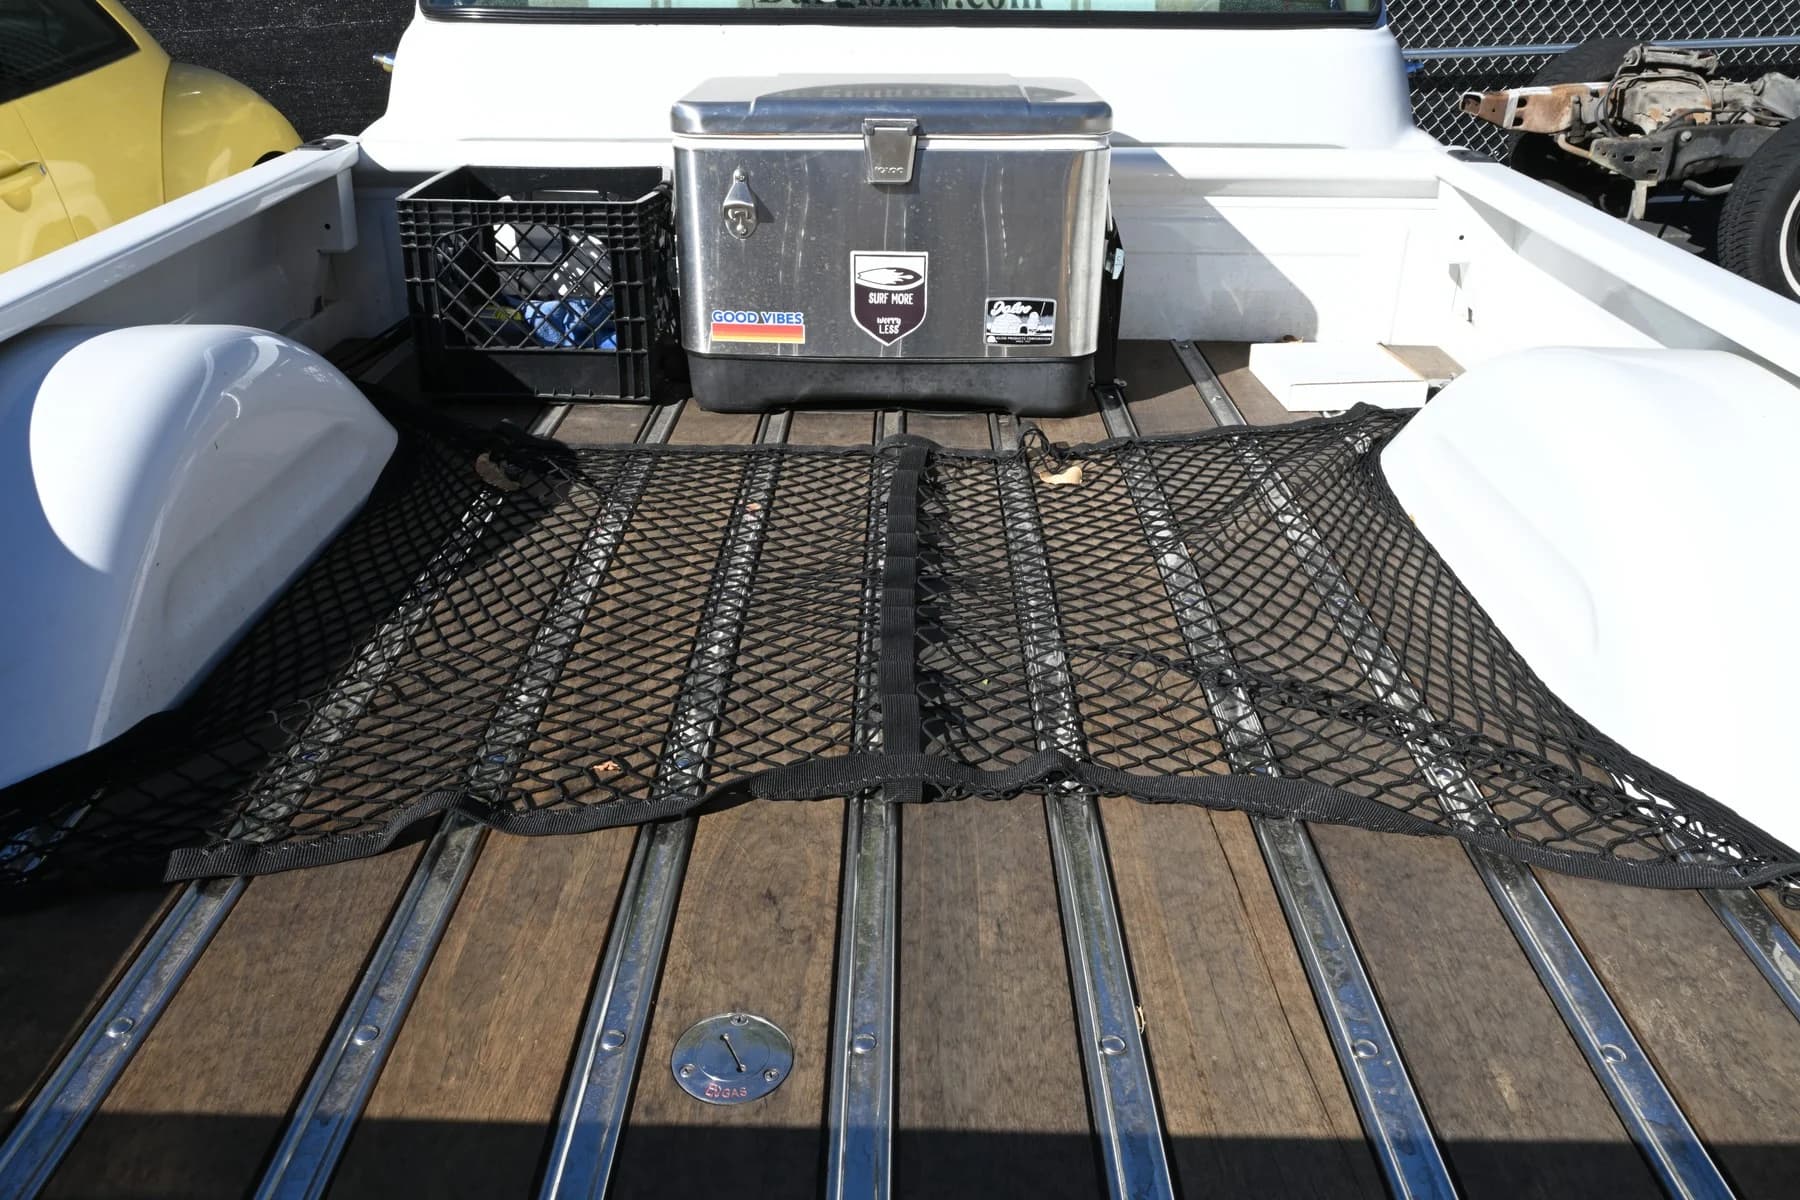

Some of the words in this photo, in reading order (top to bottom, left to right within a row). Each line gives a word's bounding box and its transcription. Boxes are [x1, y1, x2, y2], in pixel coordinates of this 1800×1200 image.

[868, 292, 888, 304] SURF
[891, 293, 914, 305] MORE
[712, 311, 758, 323] GOOD
[761, 312, 803, 324] VIBES
[879, 325, 900, 334] LESS
[721, 1087, 748, 1098] GAS
